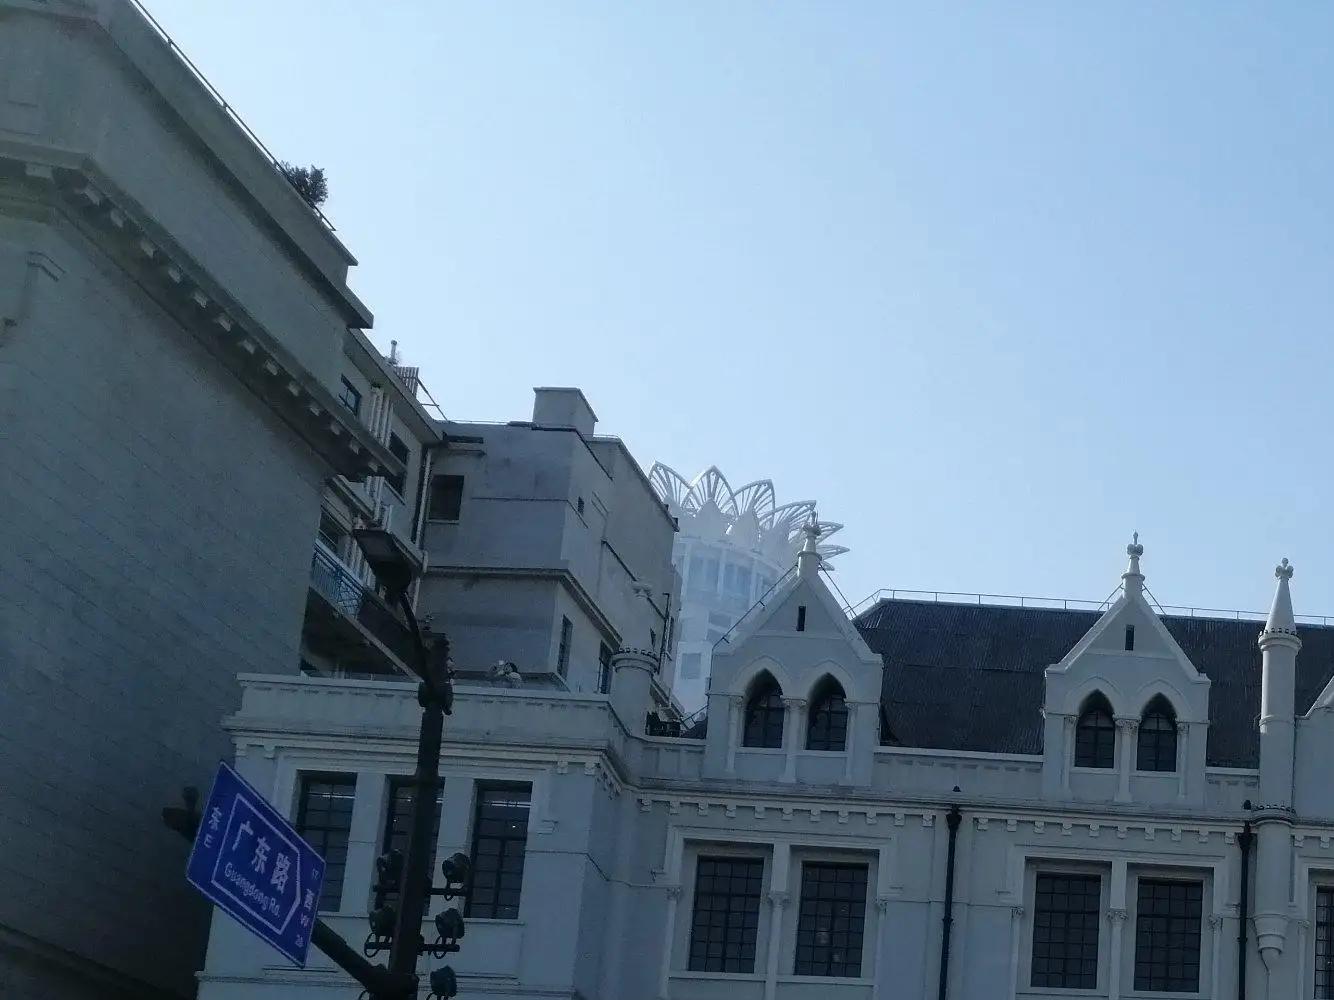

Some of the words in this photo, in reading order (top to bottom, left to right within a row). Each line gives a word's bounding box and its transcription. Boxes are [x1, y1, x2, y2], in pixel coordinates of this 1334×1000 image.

[203, 834, 213, 848] E
[232, 820, 291, 894] 广东路
[224, 862, 269, 911] Guangdong
